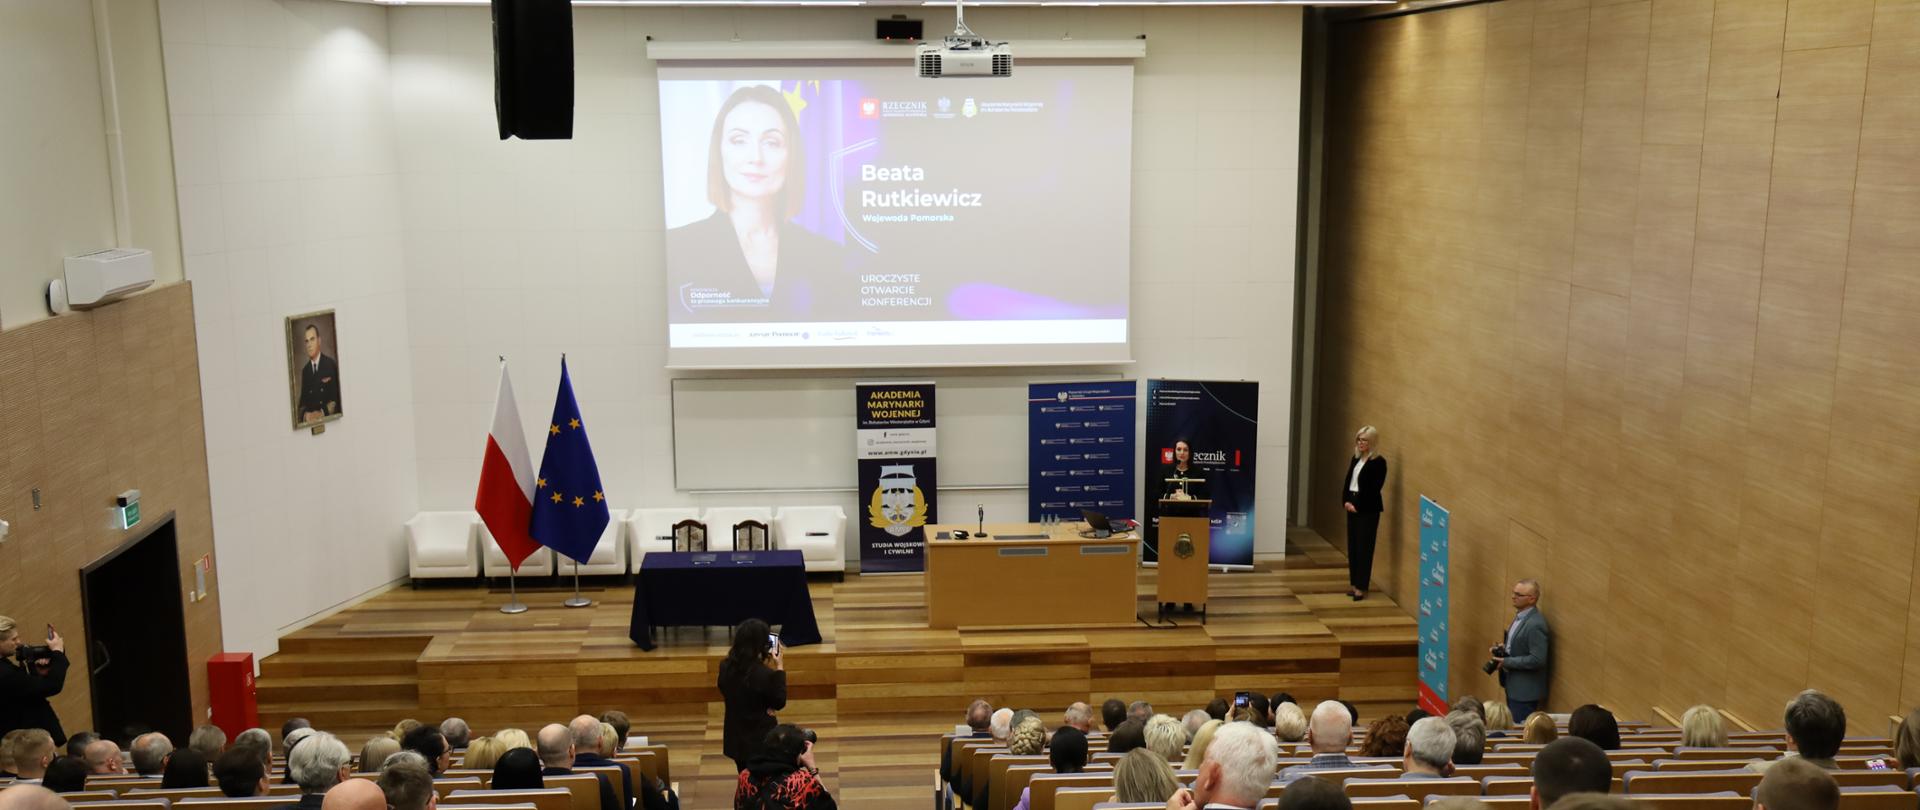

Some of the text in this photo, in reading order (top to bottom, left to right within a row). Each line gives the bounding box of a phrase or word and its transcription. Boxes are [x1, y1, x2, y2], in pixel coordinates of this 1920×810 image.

[882, 102, 927, 110] RZECZNIK
[862, 165, 924, 181] Beata
[862, 188, 982, 207] Rutkiewicz
[862, 213, 954, 223] Wojewoda Pomorska
[861, 274, 921, 283] UROCZYSTE
[861, 286, 915, 295] OTWARCIE
[861, 297, 932, 306] KONFERENCJI
[870, 391, 921, 399] AKADEMIA
[867, 400, 924, 409] MARYNARKI
[871, 410, 921, 418] WOJENNEJ
[1193, 450, 1226, 461] ecznik
